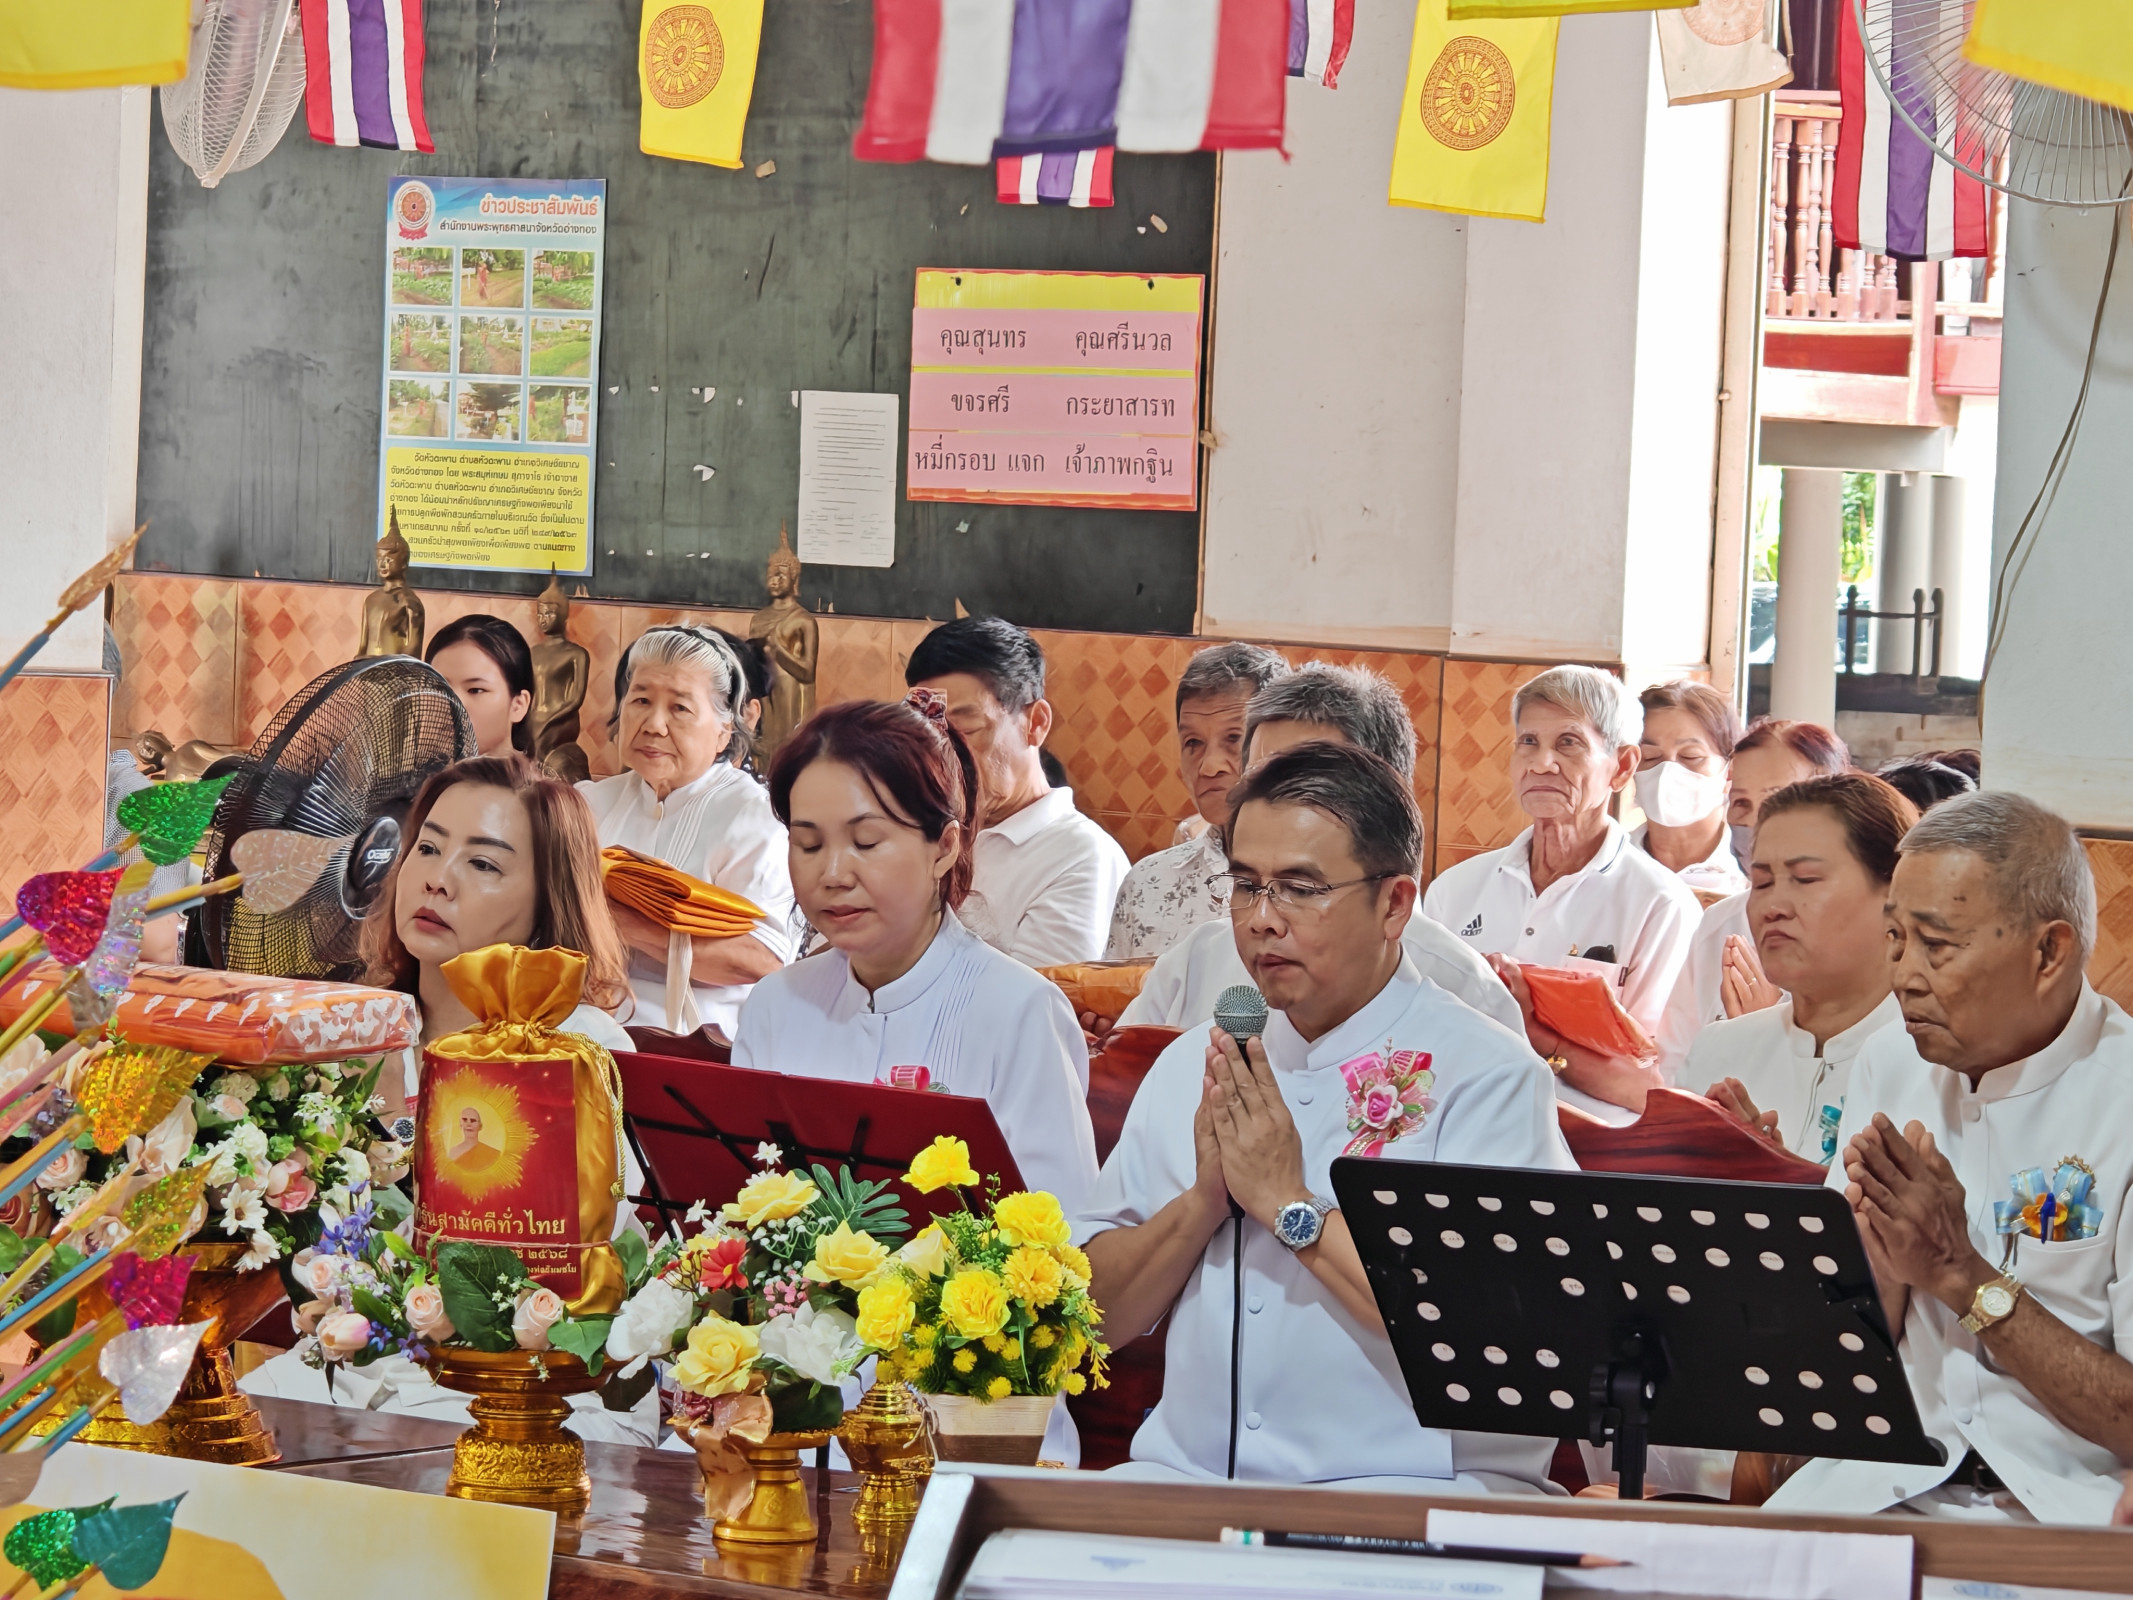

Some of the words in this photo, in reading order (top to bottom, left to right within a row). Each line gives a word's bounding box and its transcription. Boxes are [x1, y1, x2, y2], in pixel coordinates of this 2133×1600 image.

[481, 193, 599, 216] ข่าวประชาสัมพันธ์
[439, 218, 597, 237] สำนักงานพระพุทธศาสนาจังหวัดอ่างทอง
[940, 327, 1027, 355] คุณสุนทร
[1075, 321, 1172, 357] คุณศรีนวล
[951, 384, 1010, 413] ขจรศรี
[1066, 395, 1175, 417] กระยาสารท
[915, 434, 996, 472] หมี่กรอบ
[1008, 452, 1045, 473] แจก
[1065, 442, 1173, 483] เจ้าภาพกฐิน
[528, 1248, 568, 1259] ๒๕๖๘
